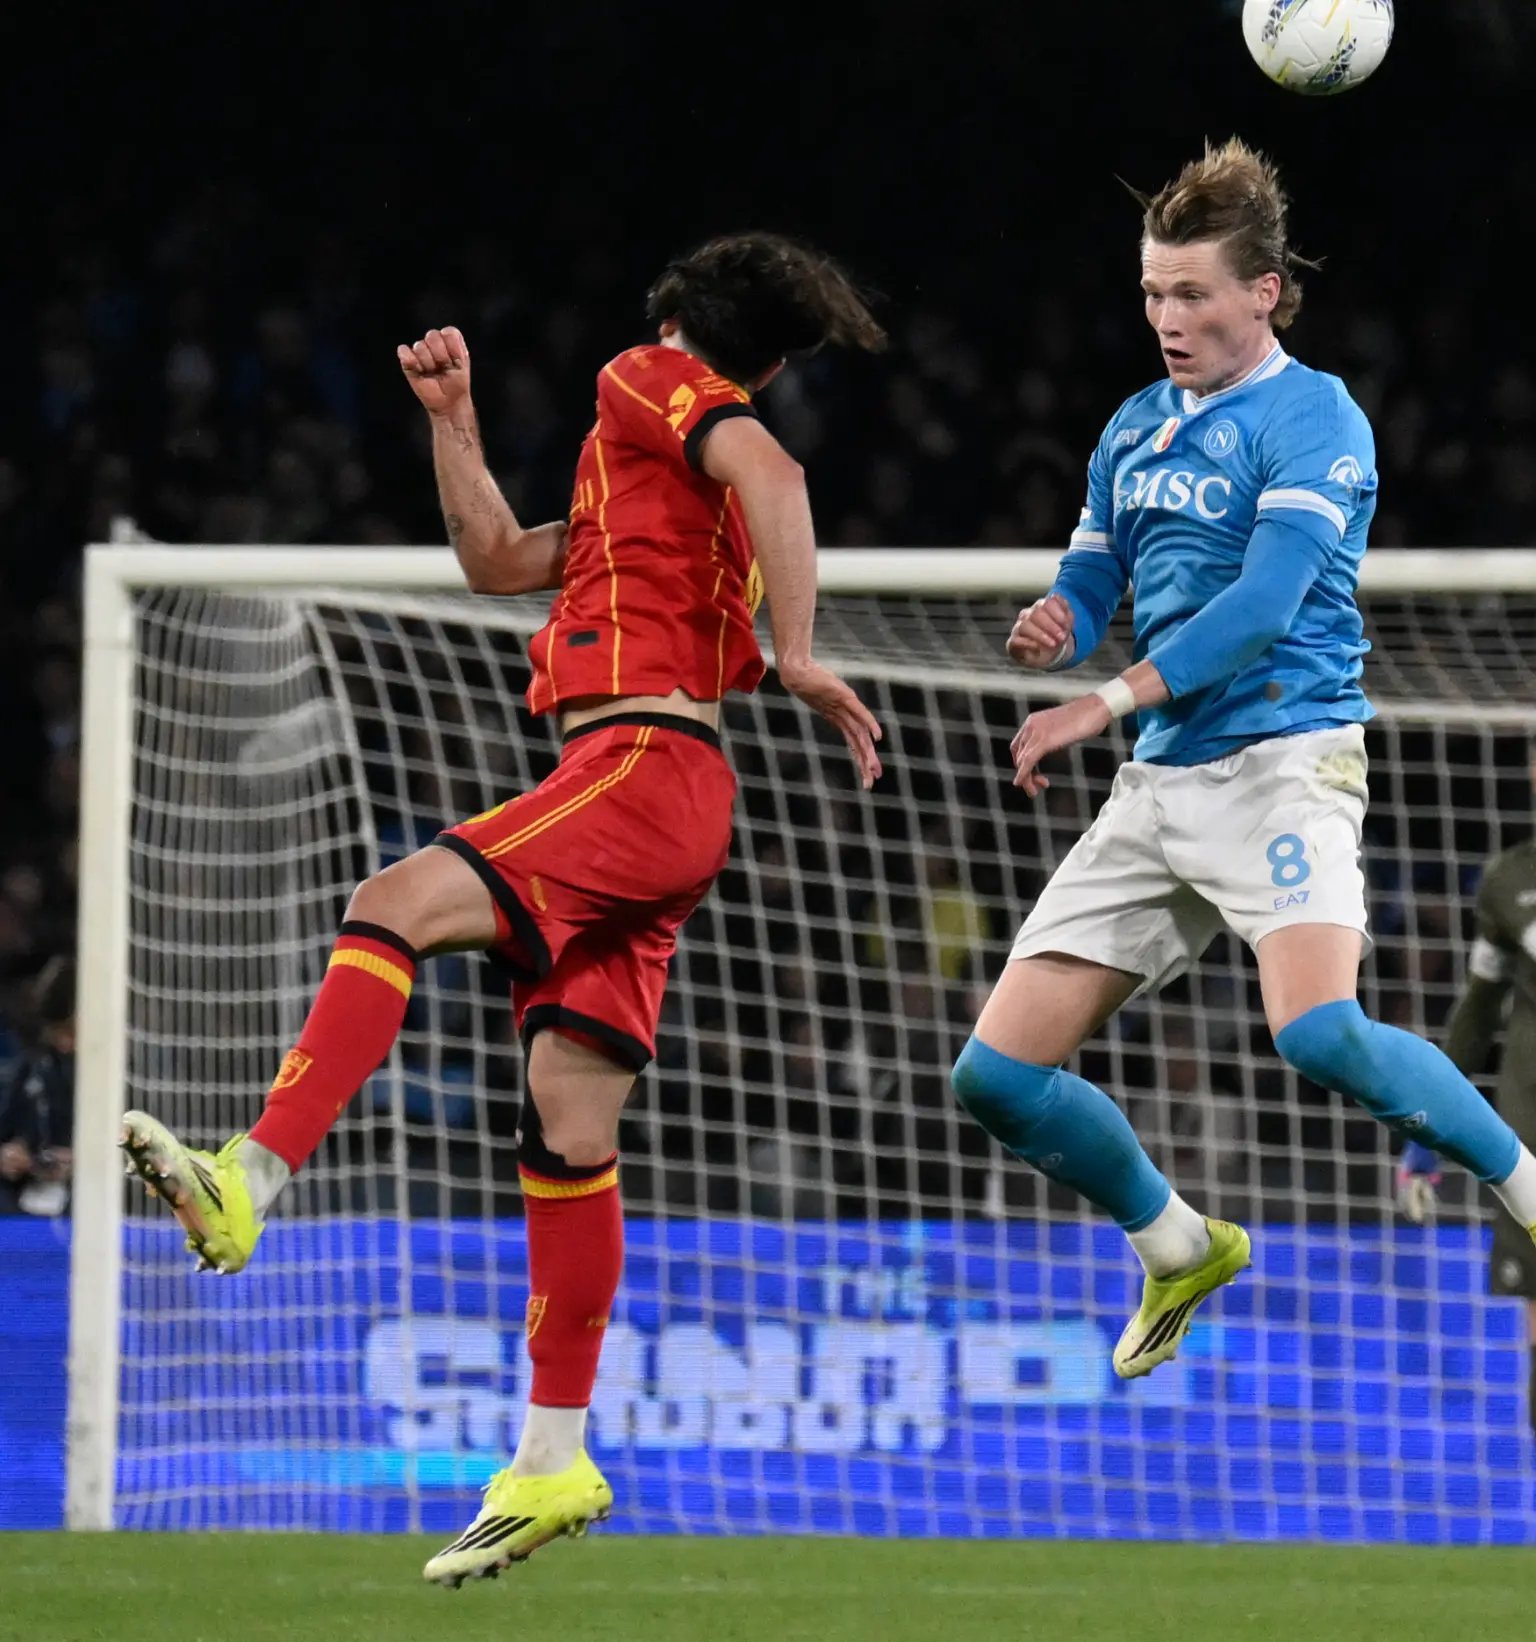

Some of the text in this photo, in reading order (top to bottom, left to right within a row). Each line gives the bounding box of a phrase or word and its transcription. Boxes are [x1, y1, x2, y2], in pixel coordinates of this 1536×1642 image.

[1126, 468, 1232, 520] MSC
[1266, 833, 1311, 887] 8
[1274, 890, 1311, 911] EA7
